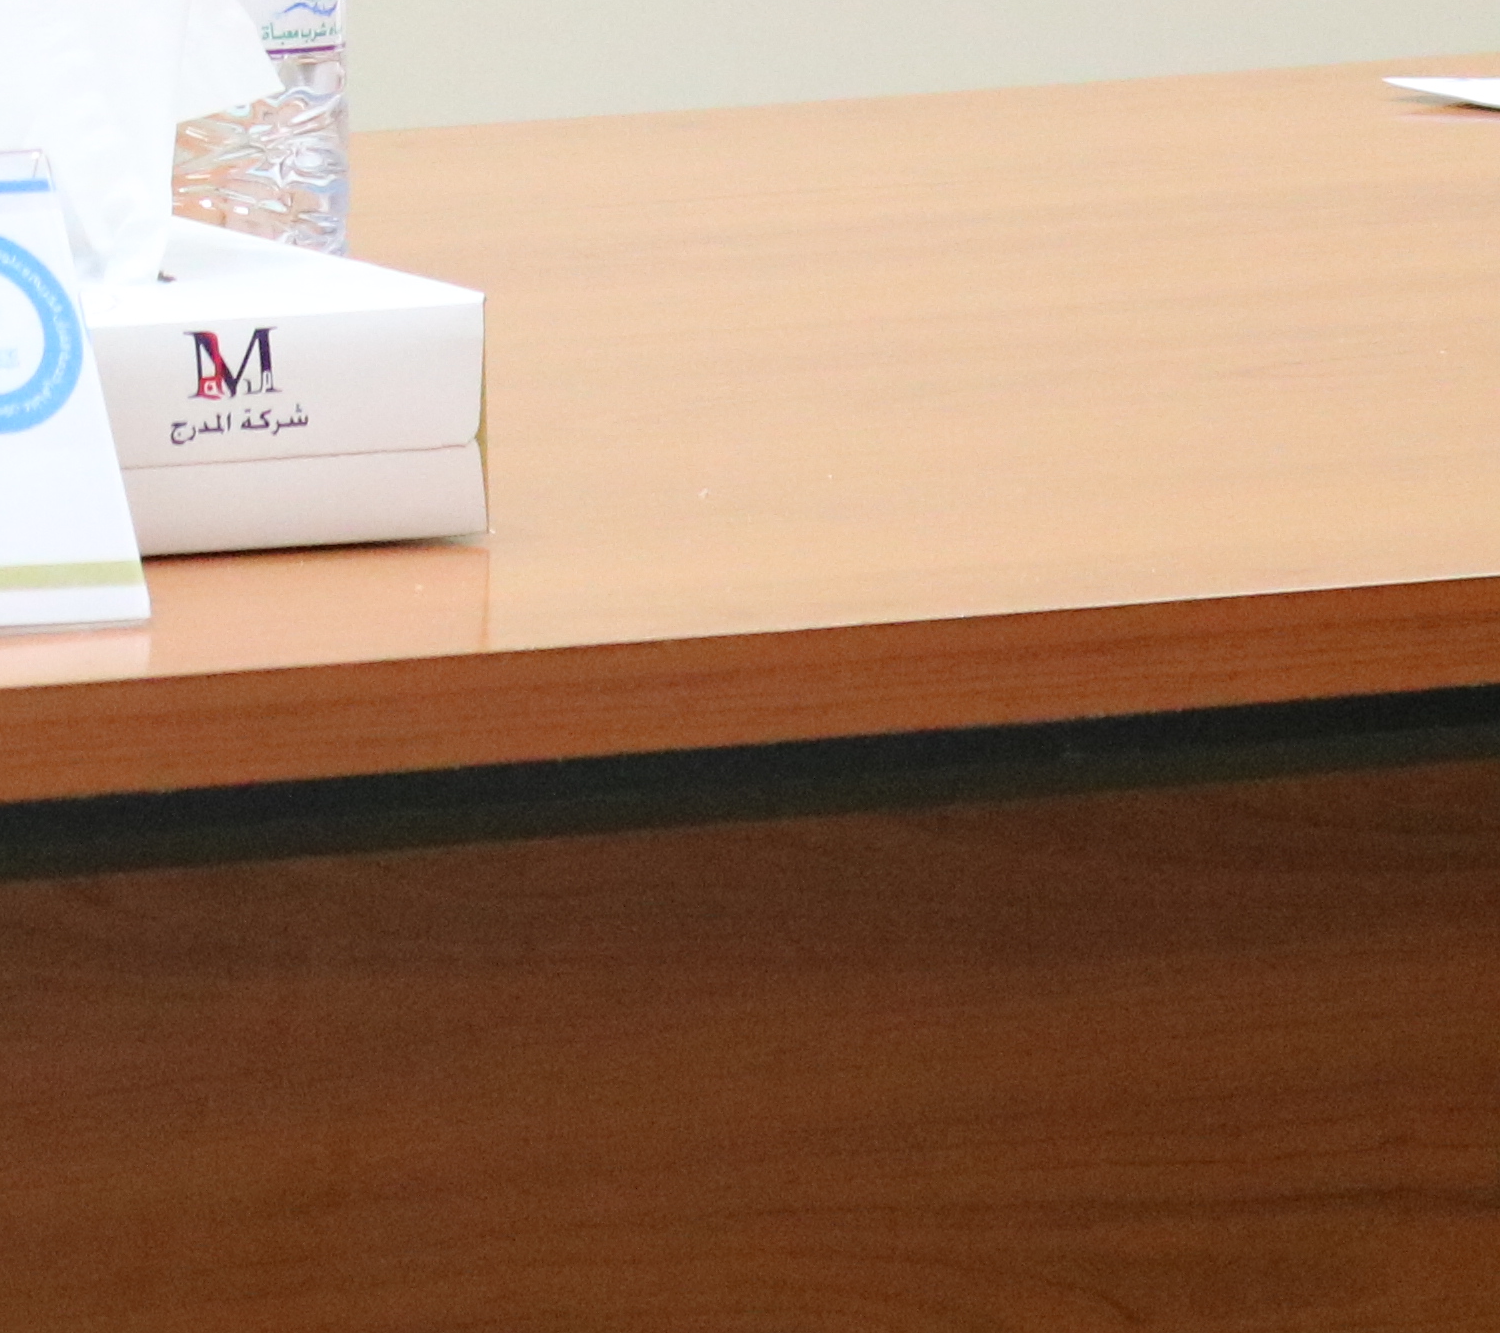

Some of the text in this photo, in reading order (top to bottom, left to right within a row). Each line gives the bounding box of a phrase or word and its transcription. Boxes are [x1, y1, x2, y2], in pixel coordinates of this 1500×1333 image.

[300, 21, 327, 43] شرب
[169, 403, 309, 446] شركة المدرج
